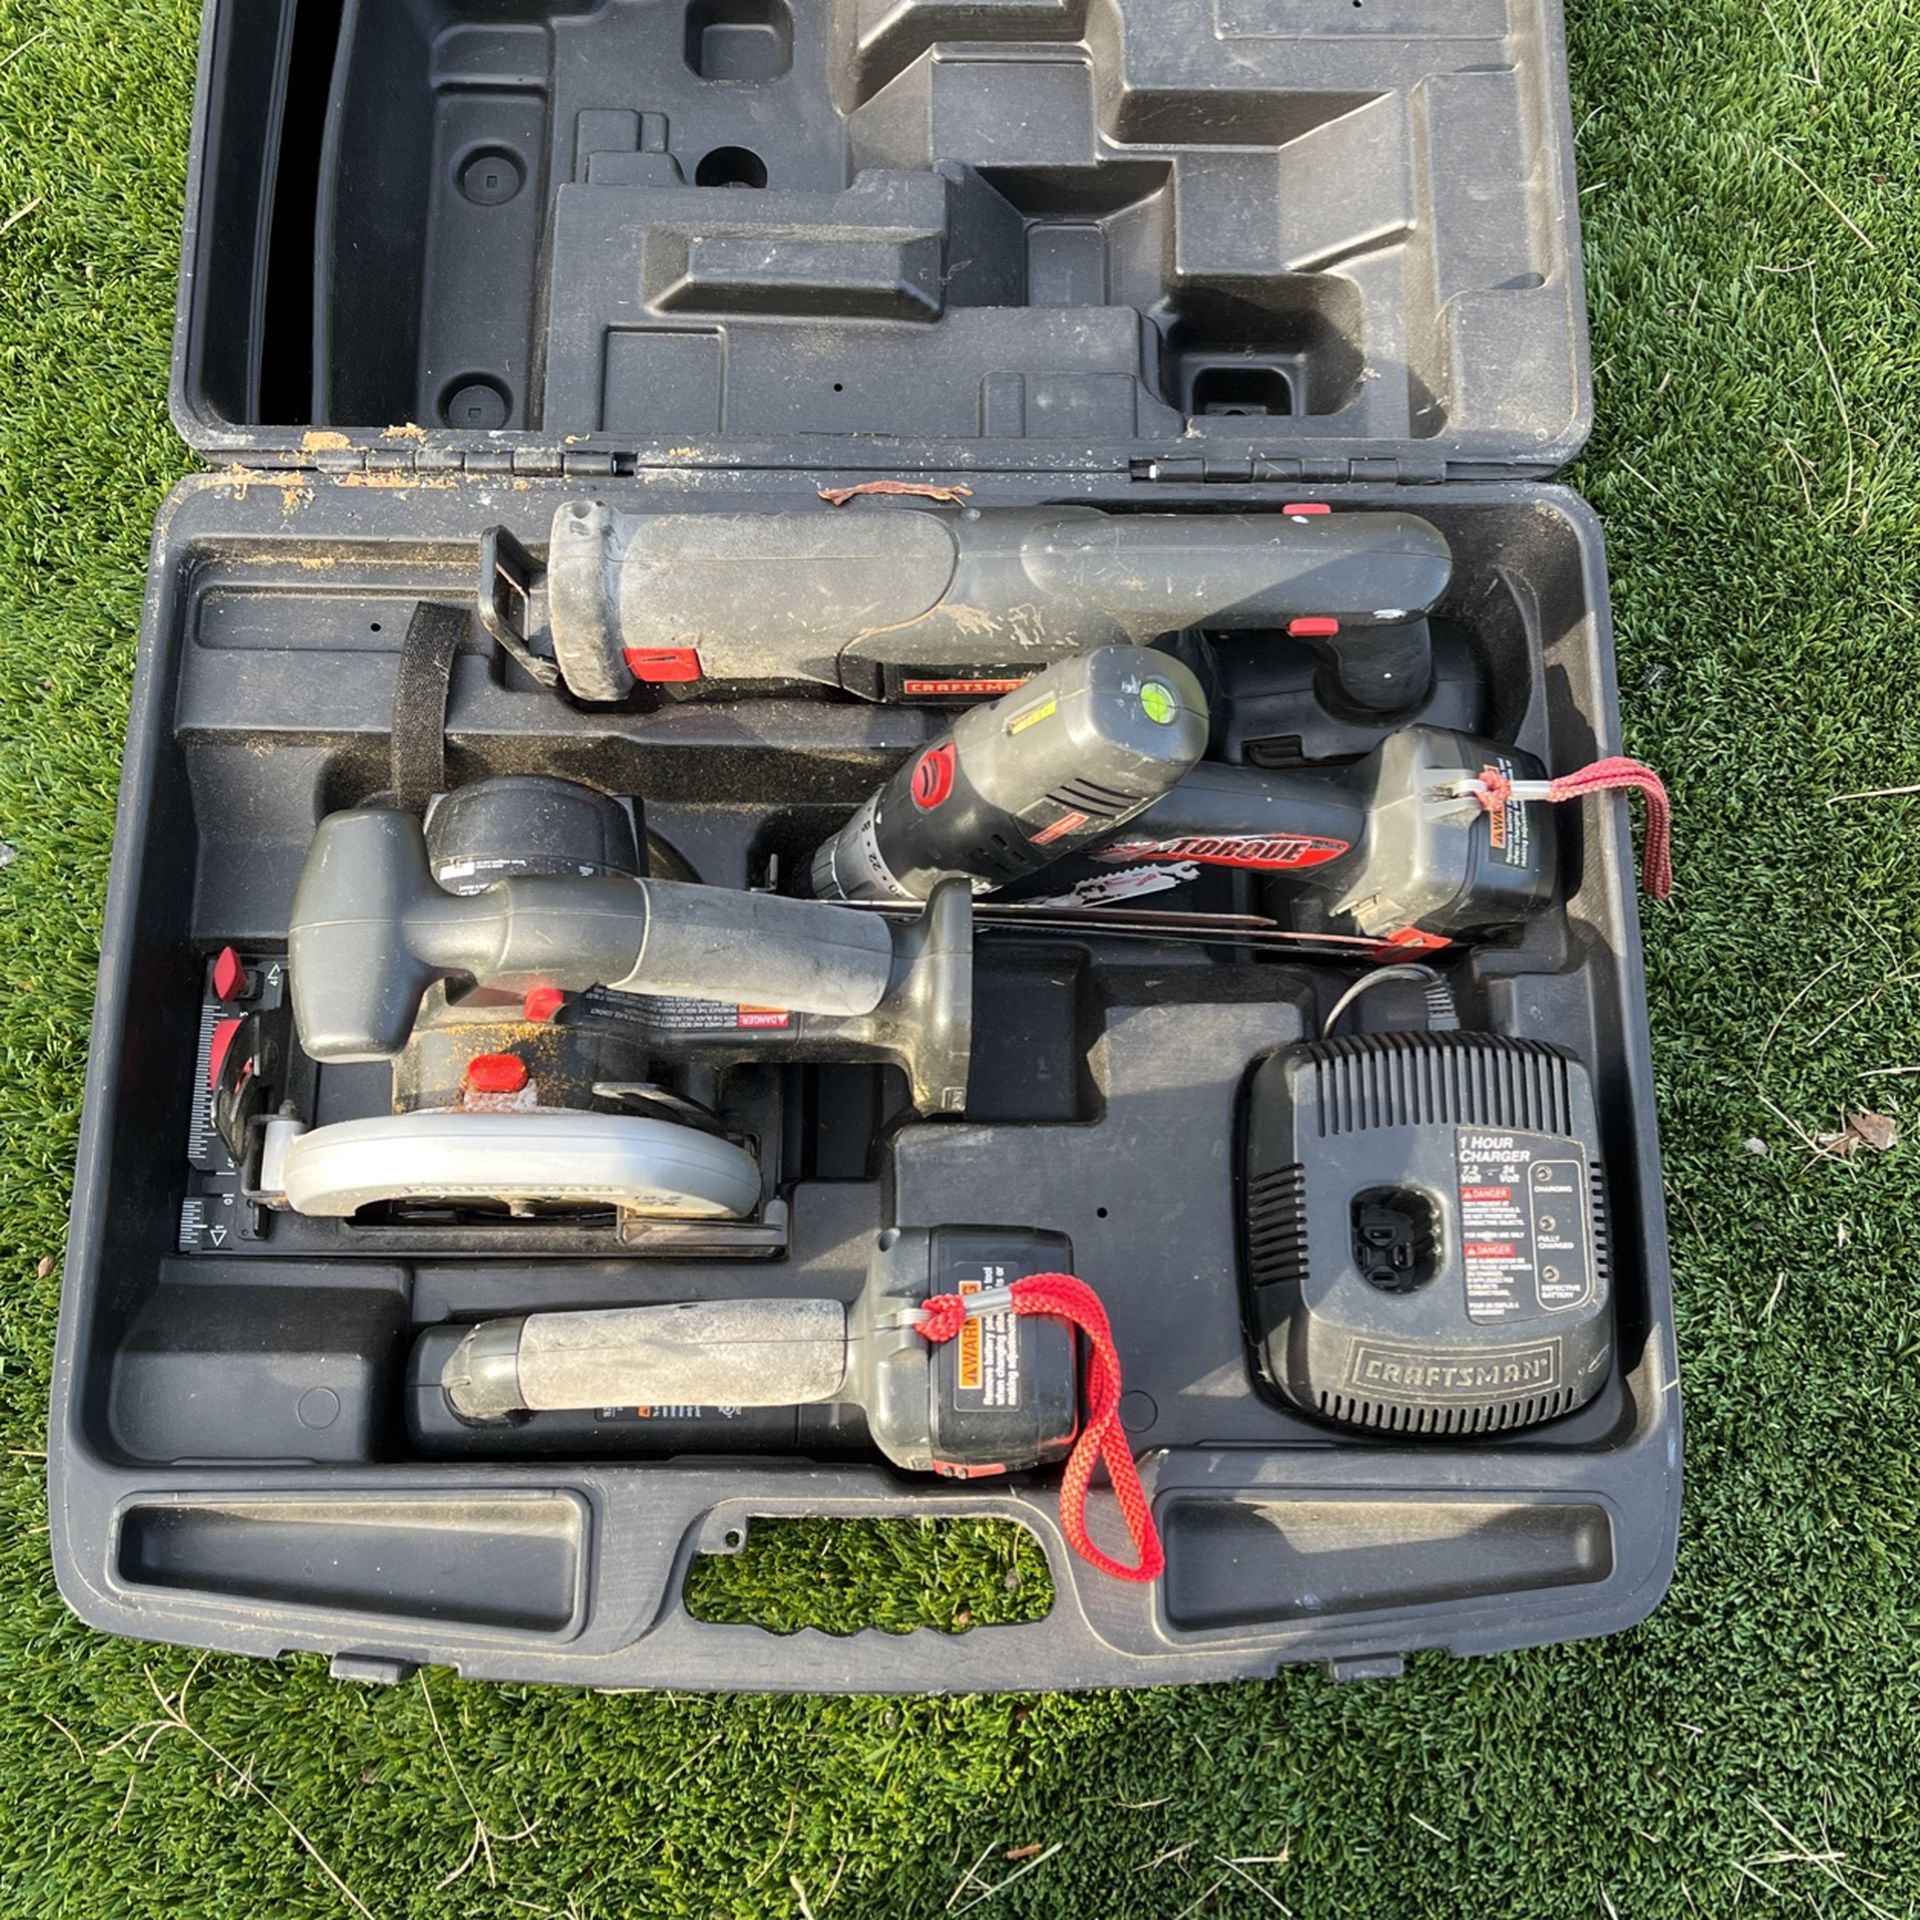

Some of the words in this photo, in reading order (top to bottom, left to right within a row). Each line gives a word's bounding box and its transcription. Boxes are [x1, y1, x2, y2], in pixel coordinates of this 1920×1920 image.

[911, 683, 1017, 692] CRAFTSMA
[1167, 839, 1312, 862] TORQUE
[1460, 1136, 1467, 1149] 1
[1471, 1136, 1513, 1149] HOUR
[1460, 1150, 1531, 1163] CHARGER
[982, 1265, 993, 1284] tool
[962, 1284, 977, 1366] WARNG
[983, 1333, 995, 1365] battery
[995, 1335, 1007, 1378] changing
[983, 1367, 994, 1405] Remove
[995, 1380, 1005, 1406] when
[1006, 1371, 1019, 1406] making
